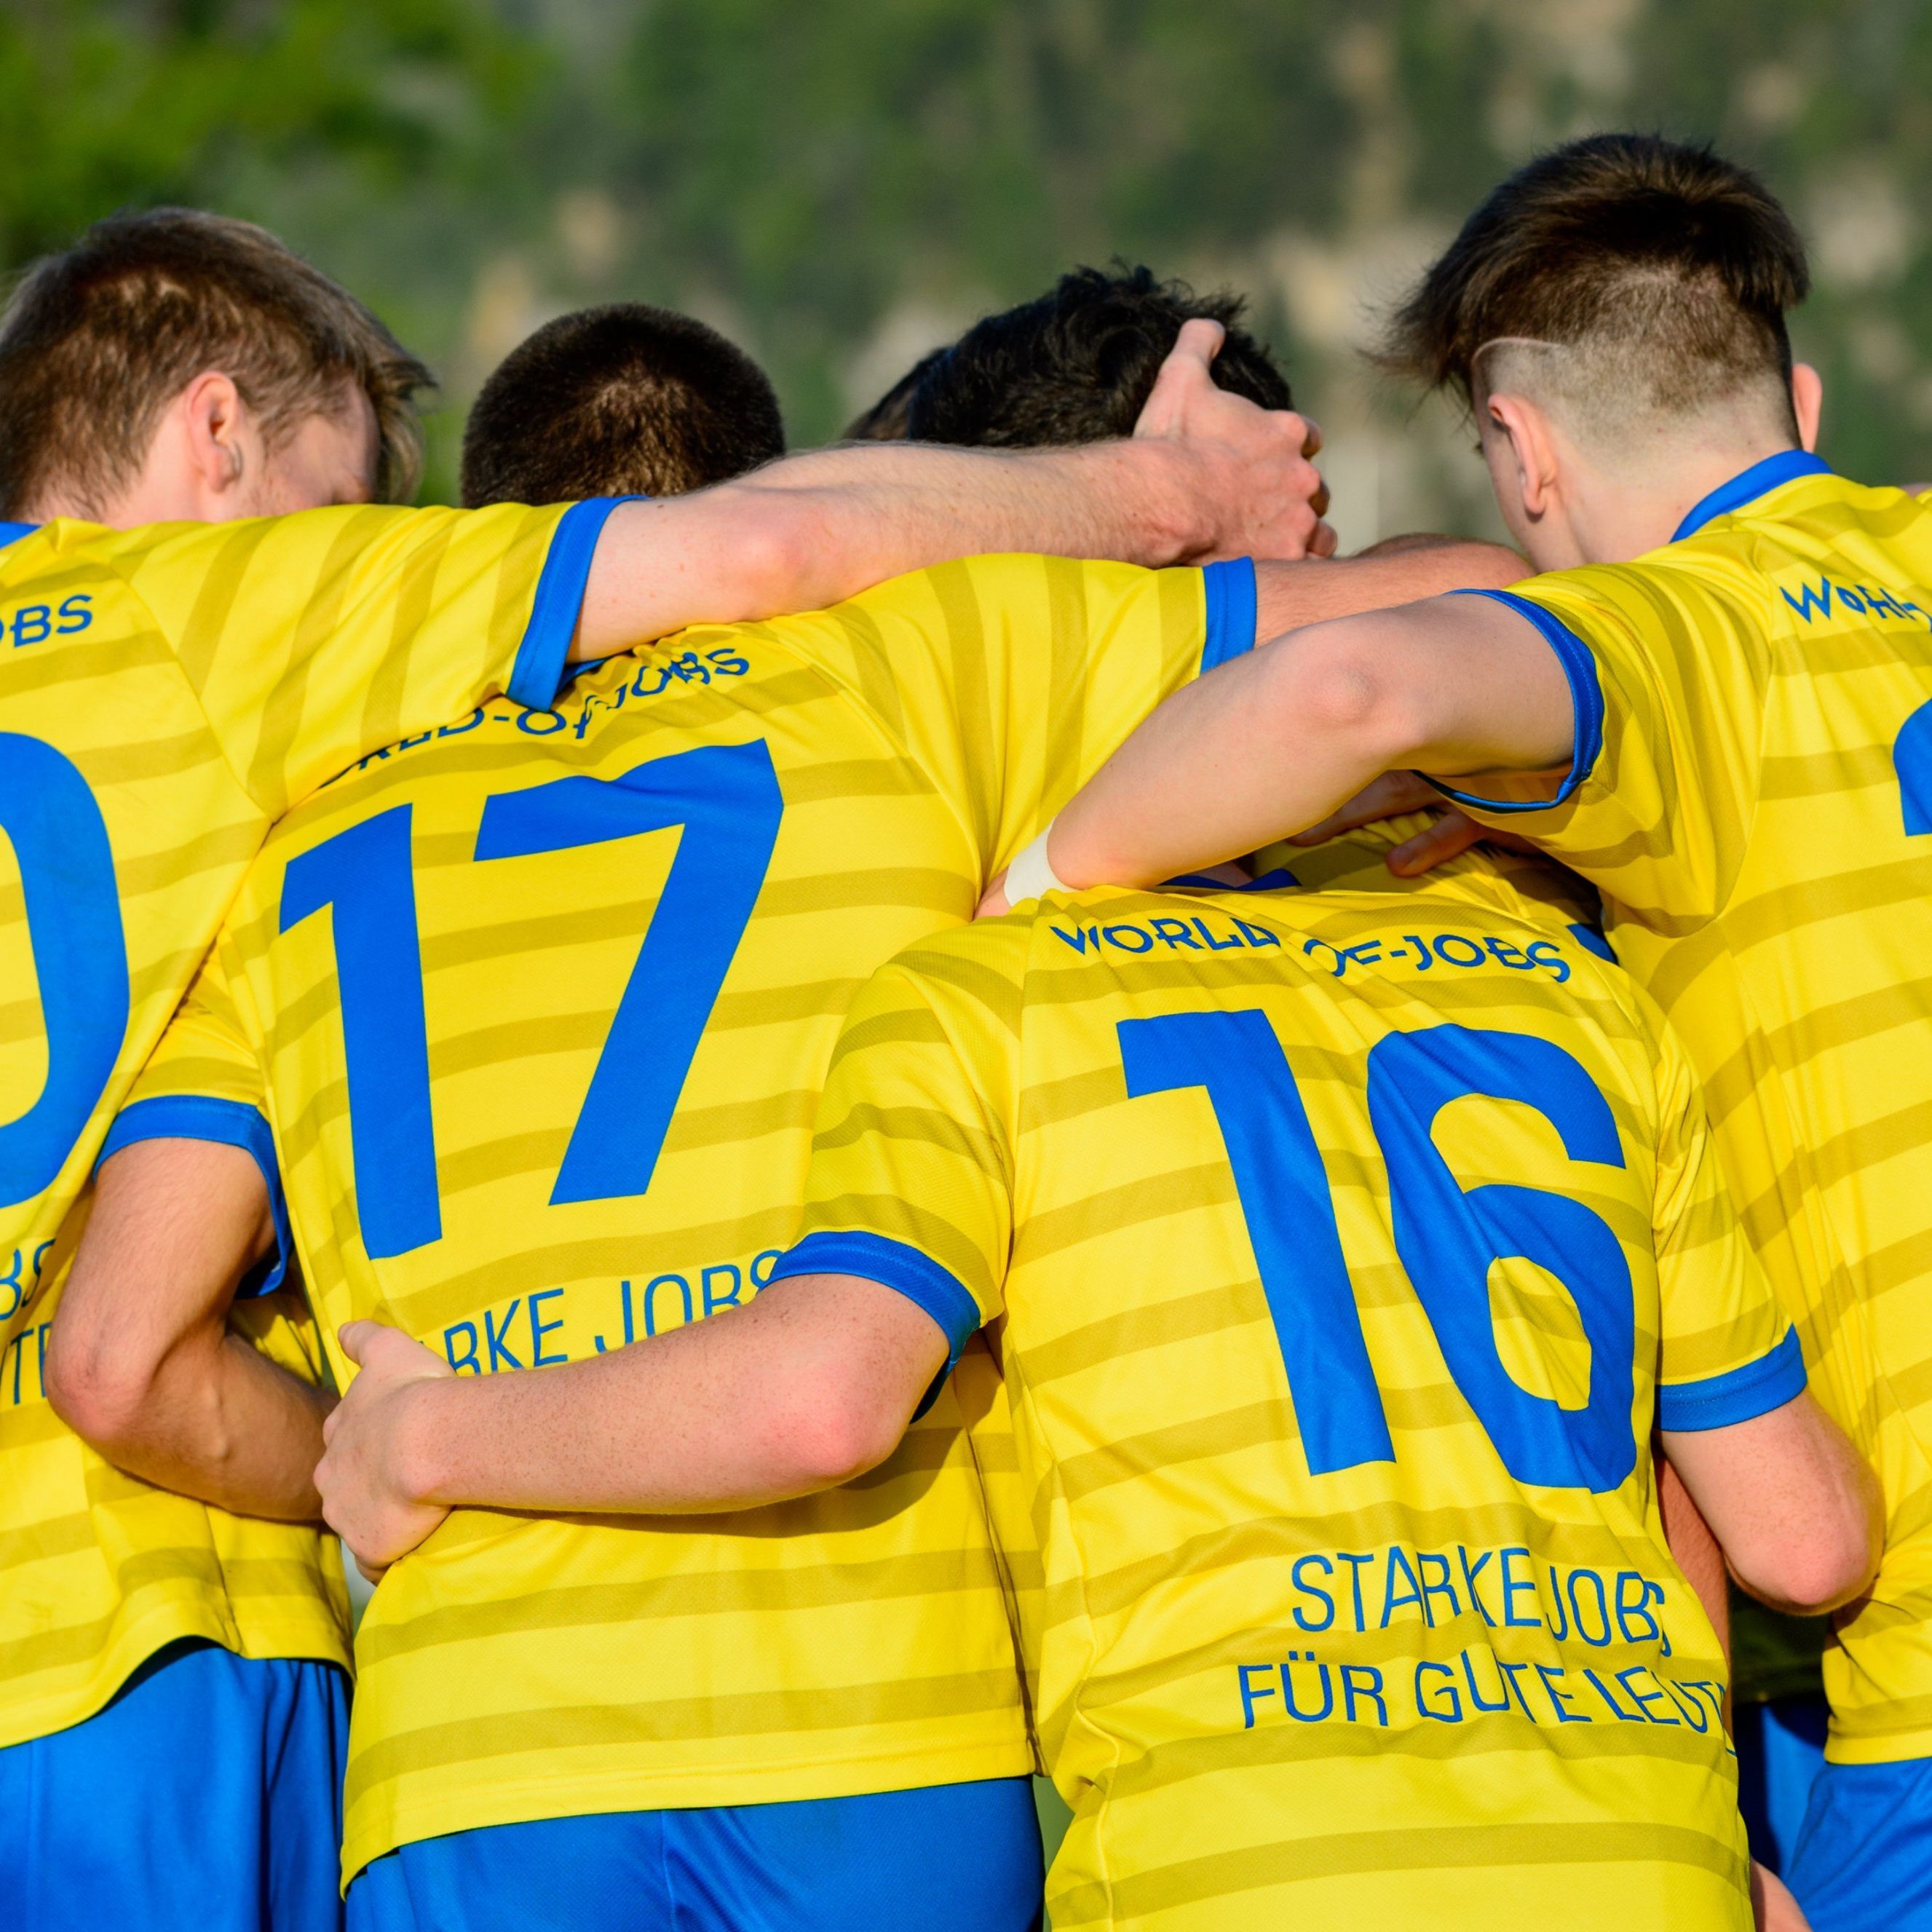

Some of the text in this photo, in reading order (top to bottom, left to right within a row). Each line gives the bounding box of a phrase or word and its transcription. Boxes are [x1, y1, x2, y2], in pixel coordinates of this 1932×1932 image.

[0, 594, 93, 648] BS
[279, 737, 785, 1261] 17
[1115, 1008, 1638, 1494] 16
[1291, 1545, 1672, 1658] STARKE JOBS
[1238, 1649, 1737, 1757] FÜR GUTE LEUT
